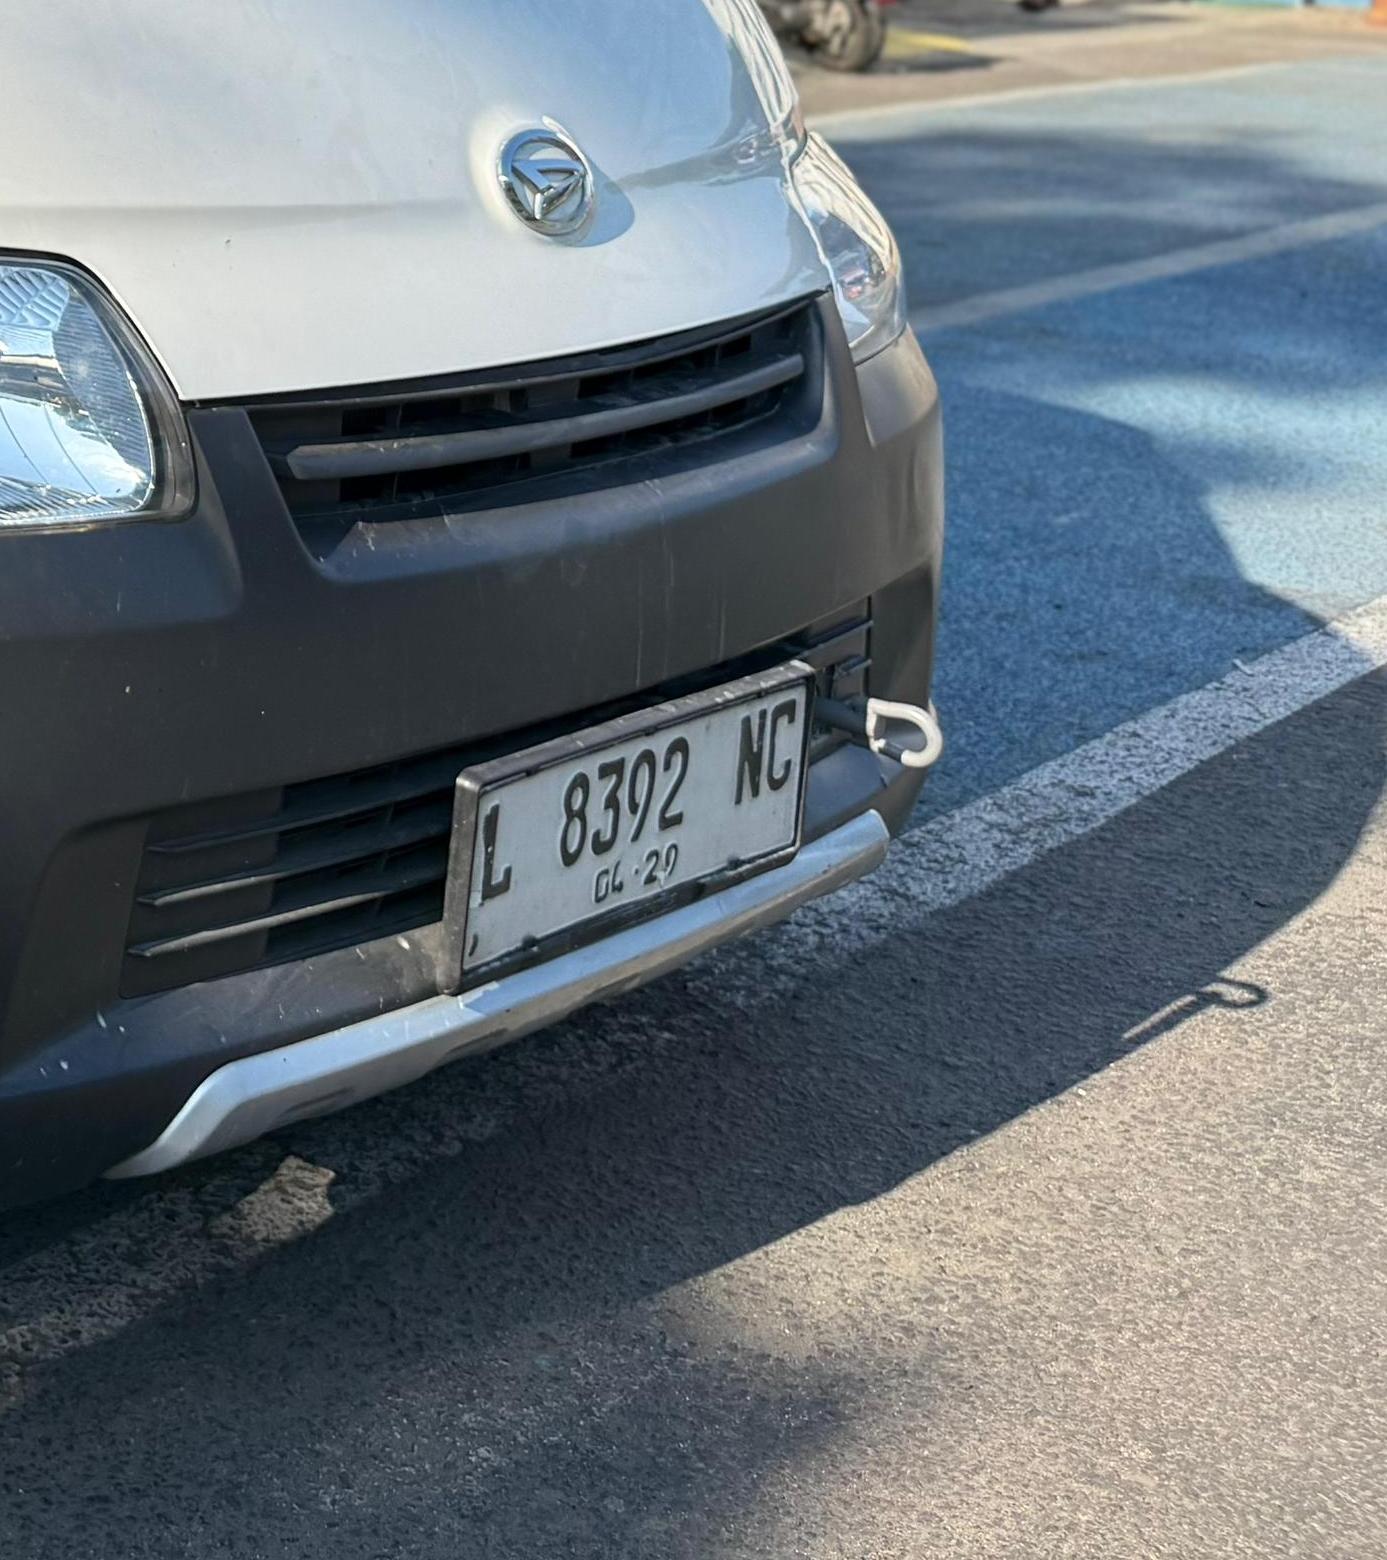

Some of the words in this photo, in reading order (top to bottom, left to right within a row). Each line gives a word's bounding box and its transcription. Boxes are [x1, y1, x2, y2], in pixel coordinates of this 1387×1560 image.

[481, 804, 512, 903] L
[559, 736, 690, 868] 8392
[734, 698, 797, 806] NC
